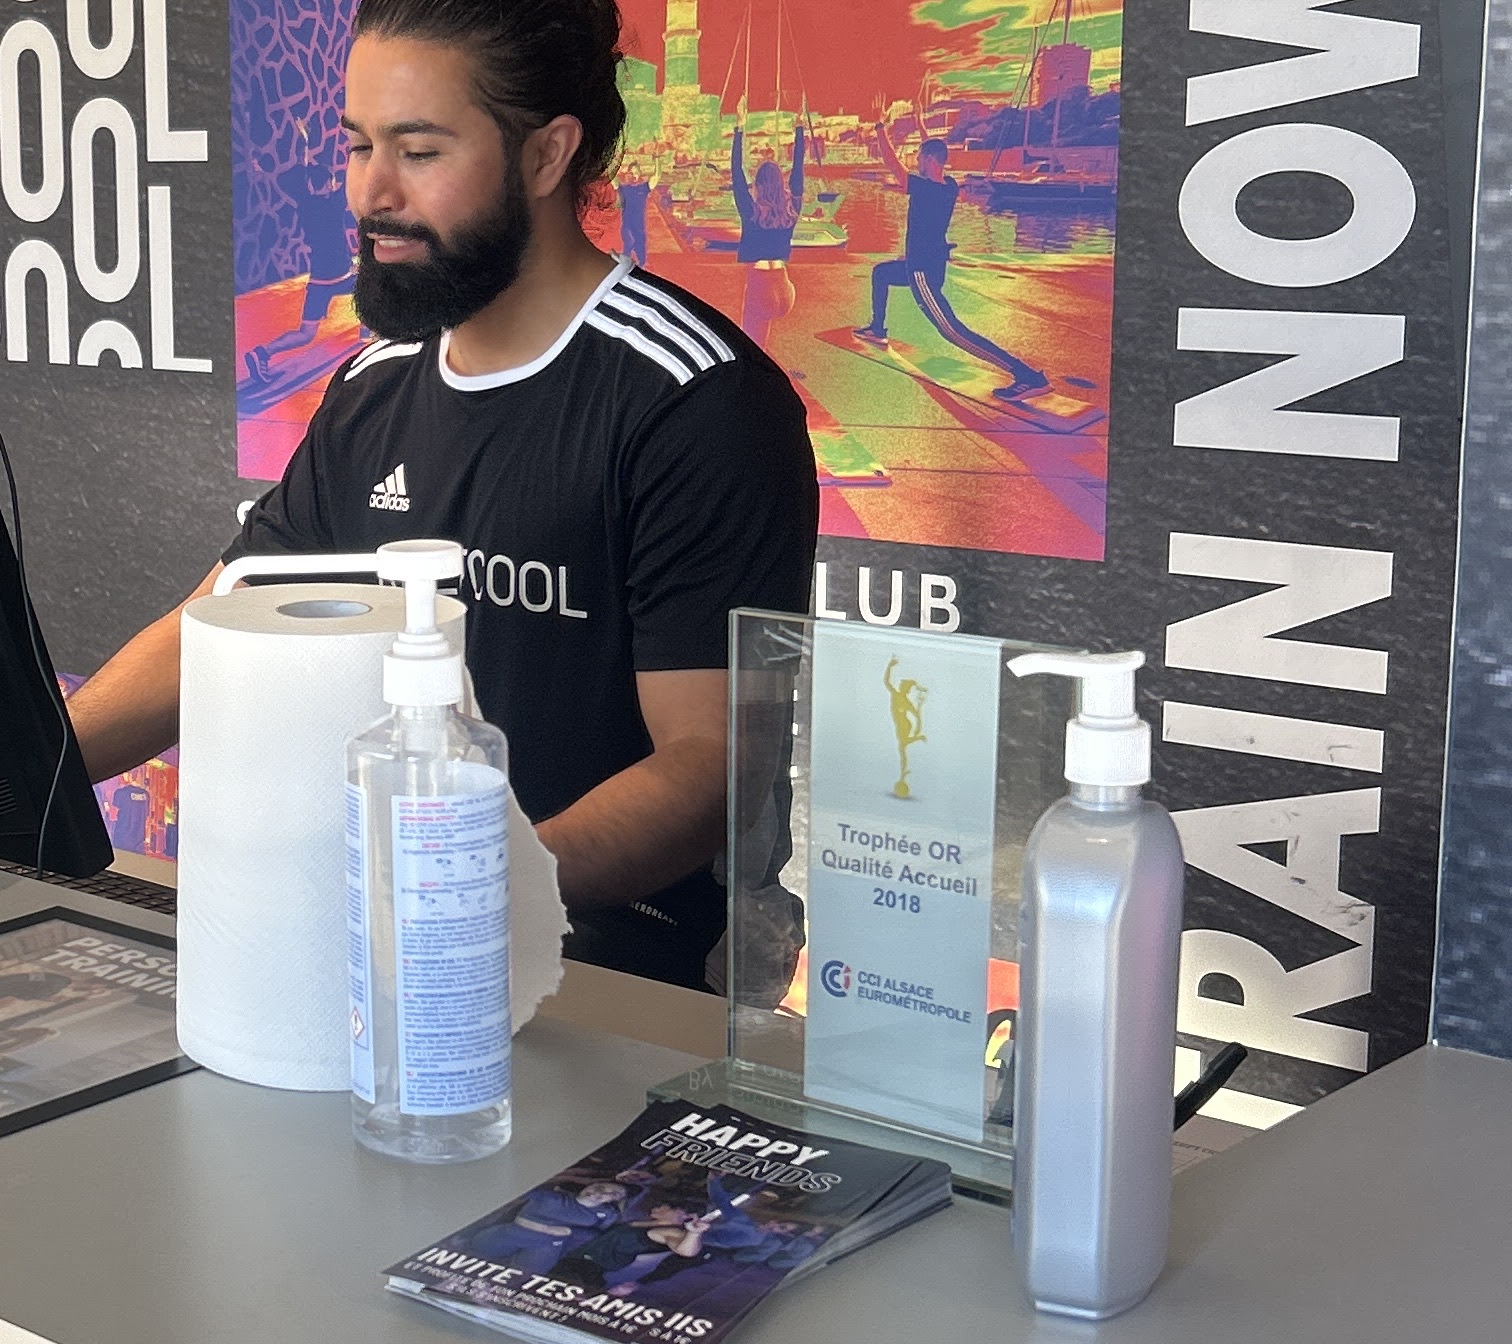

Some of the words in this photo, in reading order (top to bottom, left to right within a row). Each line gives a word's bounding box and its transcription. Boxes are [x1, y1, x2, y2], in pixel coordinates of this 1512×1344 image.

[369, 493, 411, 512] adidas
[815, 561, 962, 634] LUB
[838, 823, 922, 856] Trophée
[928, 841, 962, 865] OR
[822, 849, 893, 879] Qualité
[898, 865, 978, 897] Accueil
[873, 887, 921, 914] 2018
[40, 948, 177, 999] TRAINI
[857, 970, 881, 988] CCI
[883, 975, 934, 1000] ALSACE
[857, 985, 972, 1024] EUROMÉTROPOLE
[639, 1129, 842, 1194] FRIENDS
[670, 1113, 830, 1167] HAPPY
[417, 1247, 523, 1285] INVITE
[521, 1274, 583, 1302] TES
[585, 1293, 664, 1326] AMIS
